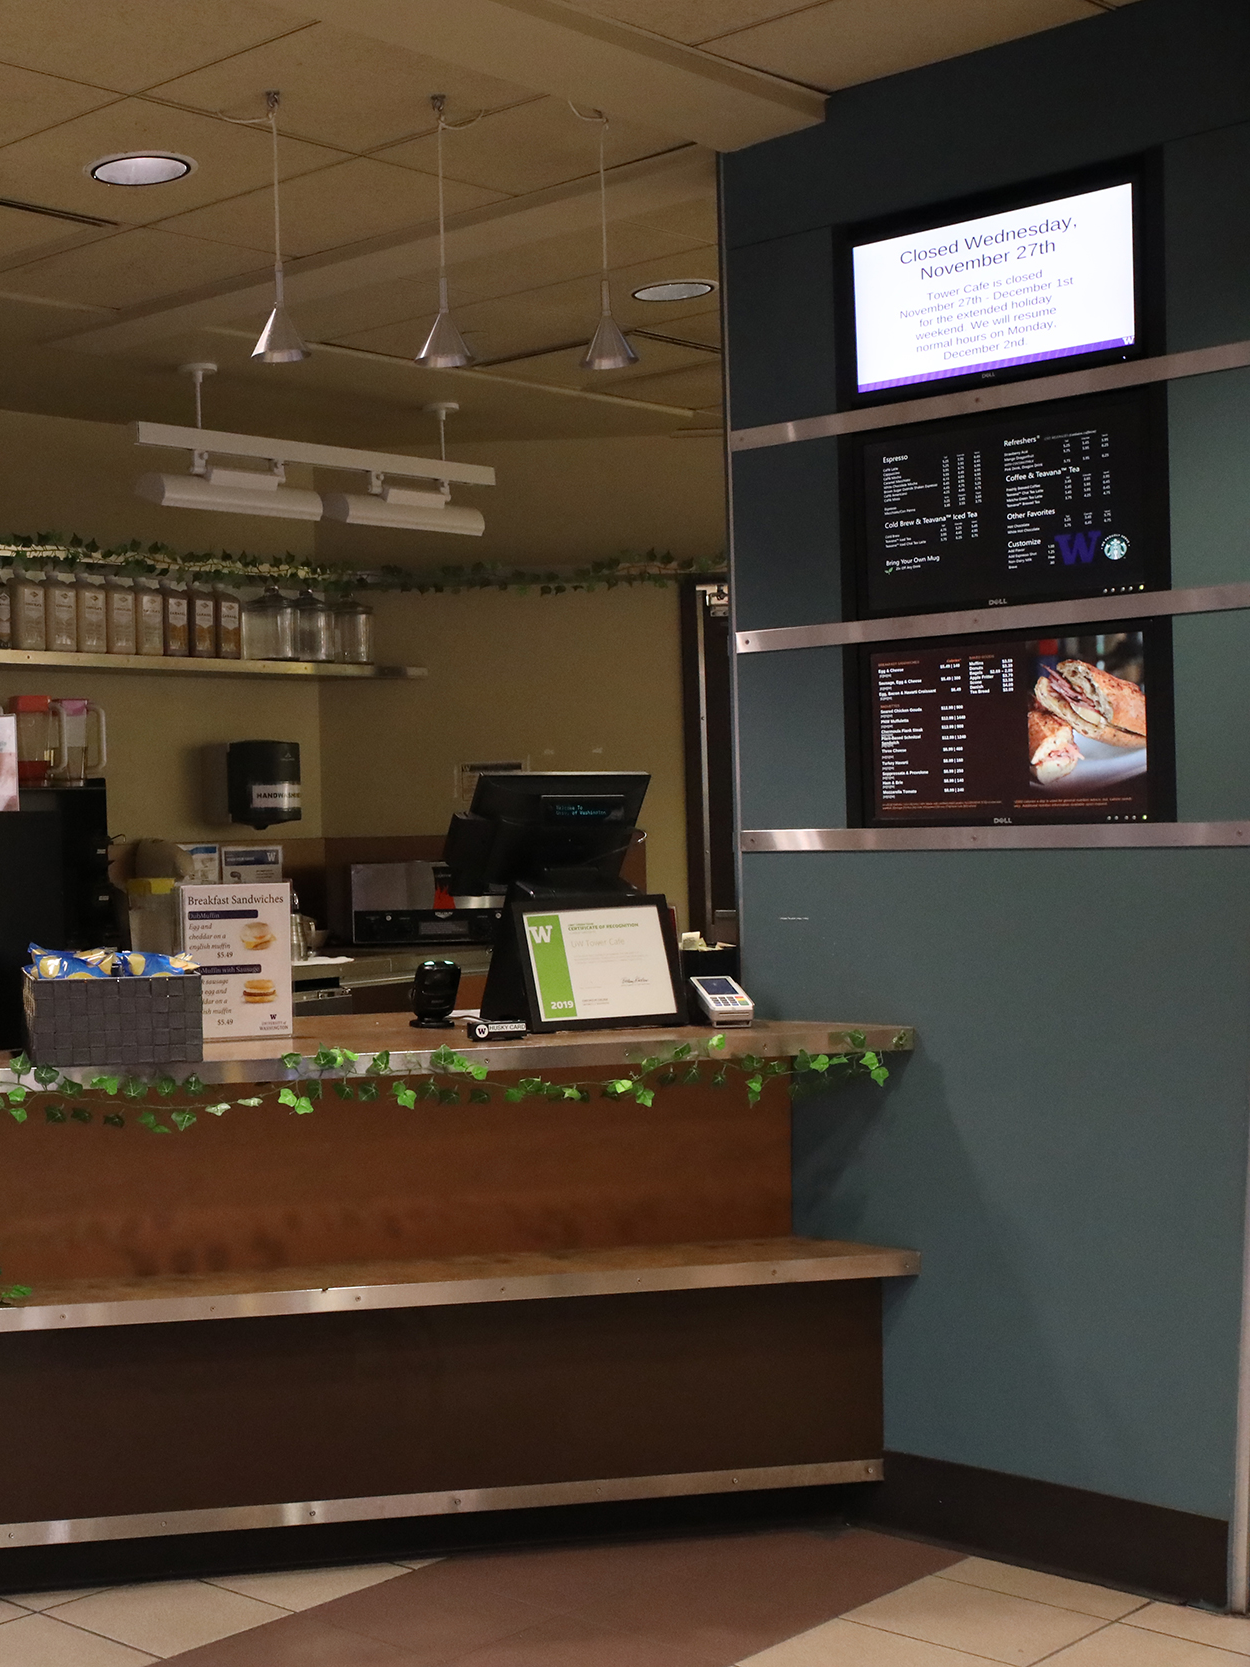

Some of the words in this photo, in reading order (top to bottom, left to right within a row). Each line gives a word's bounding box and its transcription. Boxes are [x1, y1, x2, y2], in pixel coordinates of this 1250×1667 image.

[900, 241, 958, 264] Closed
[964, 218, 1077, 250] Wednesday,
[921, 252, 1009, 279] November
[1017, 240, 1055, 259] 27th
[900, 301, 954, 318] November
[959, 296, 982, 307] 27th
[994, 283, 1051, 299] December
[1058, 277, 1073, 287] 1st
[928, 289, 959, 300] Tower
[964, 282, 989, 293] Cafe
[1006, 270, 1042, 284] closed
[916, 323, 964, 340] weekend.
[970, 319, 989, 330] We
[992, 314, 1009, 325] will
[1014, 308, 1056, 321] resume
[920, 317, 933, 326] for
[936, 312, 953, 324] the
[957, 303, 1007, 320] extended
[1012, 295, 1052, 309] holiday
[916, 338, 952, 352] normal
[956, 332, 986, 345] hours
[990, 330, 1004, 338] on
[1008, 321, 1056, 335] Monday,
[944, 343, 999, 360] December
[1004, 337, 1027, 349] 2nd.
[1054, 530, 1101, 565] W
[267, 853, 276, 861] W
[188, 894, 229, 906] Breakfast
[232, 894, 284, 904] Sandwiches
[189, 943, 210, 951] english
[528, 925, 552, 944] W
[551, 1001, 573, 1009] 2019
